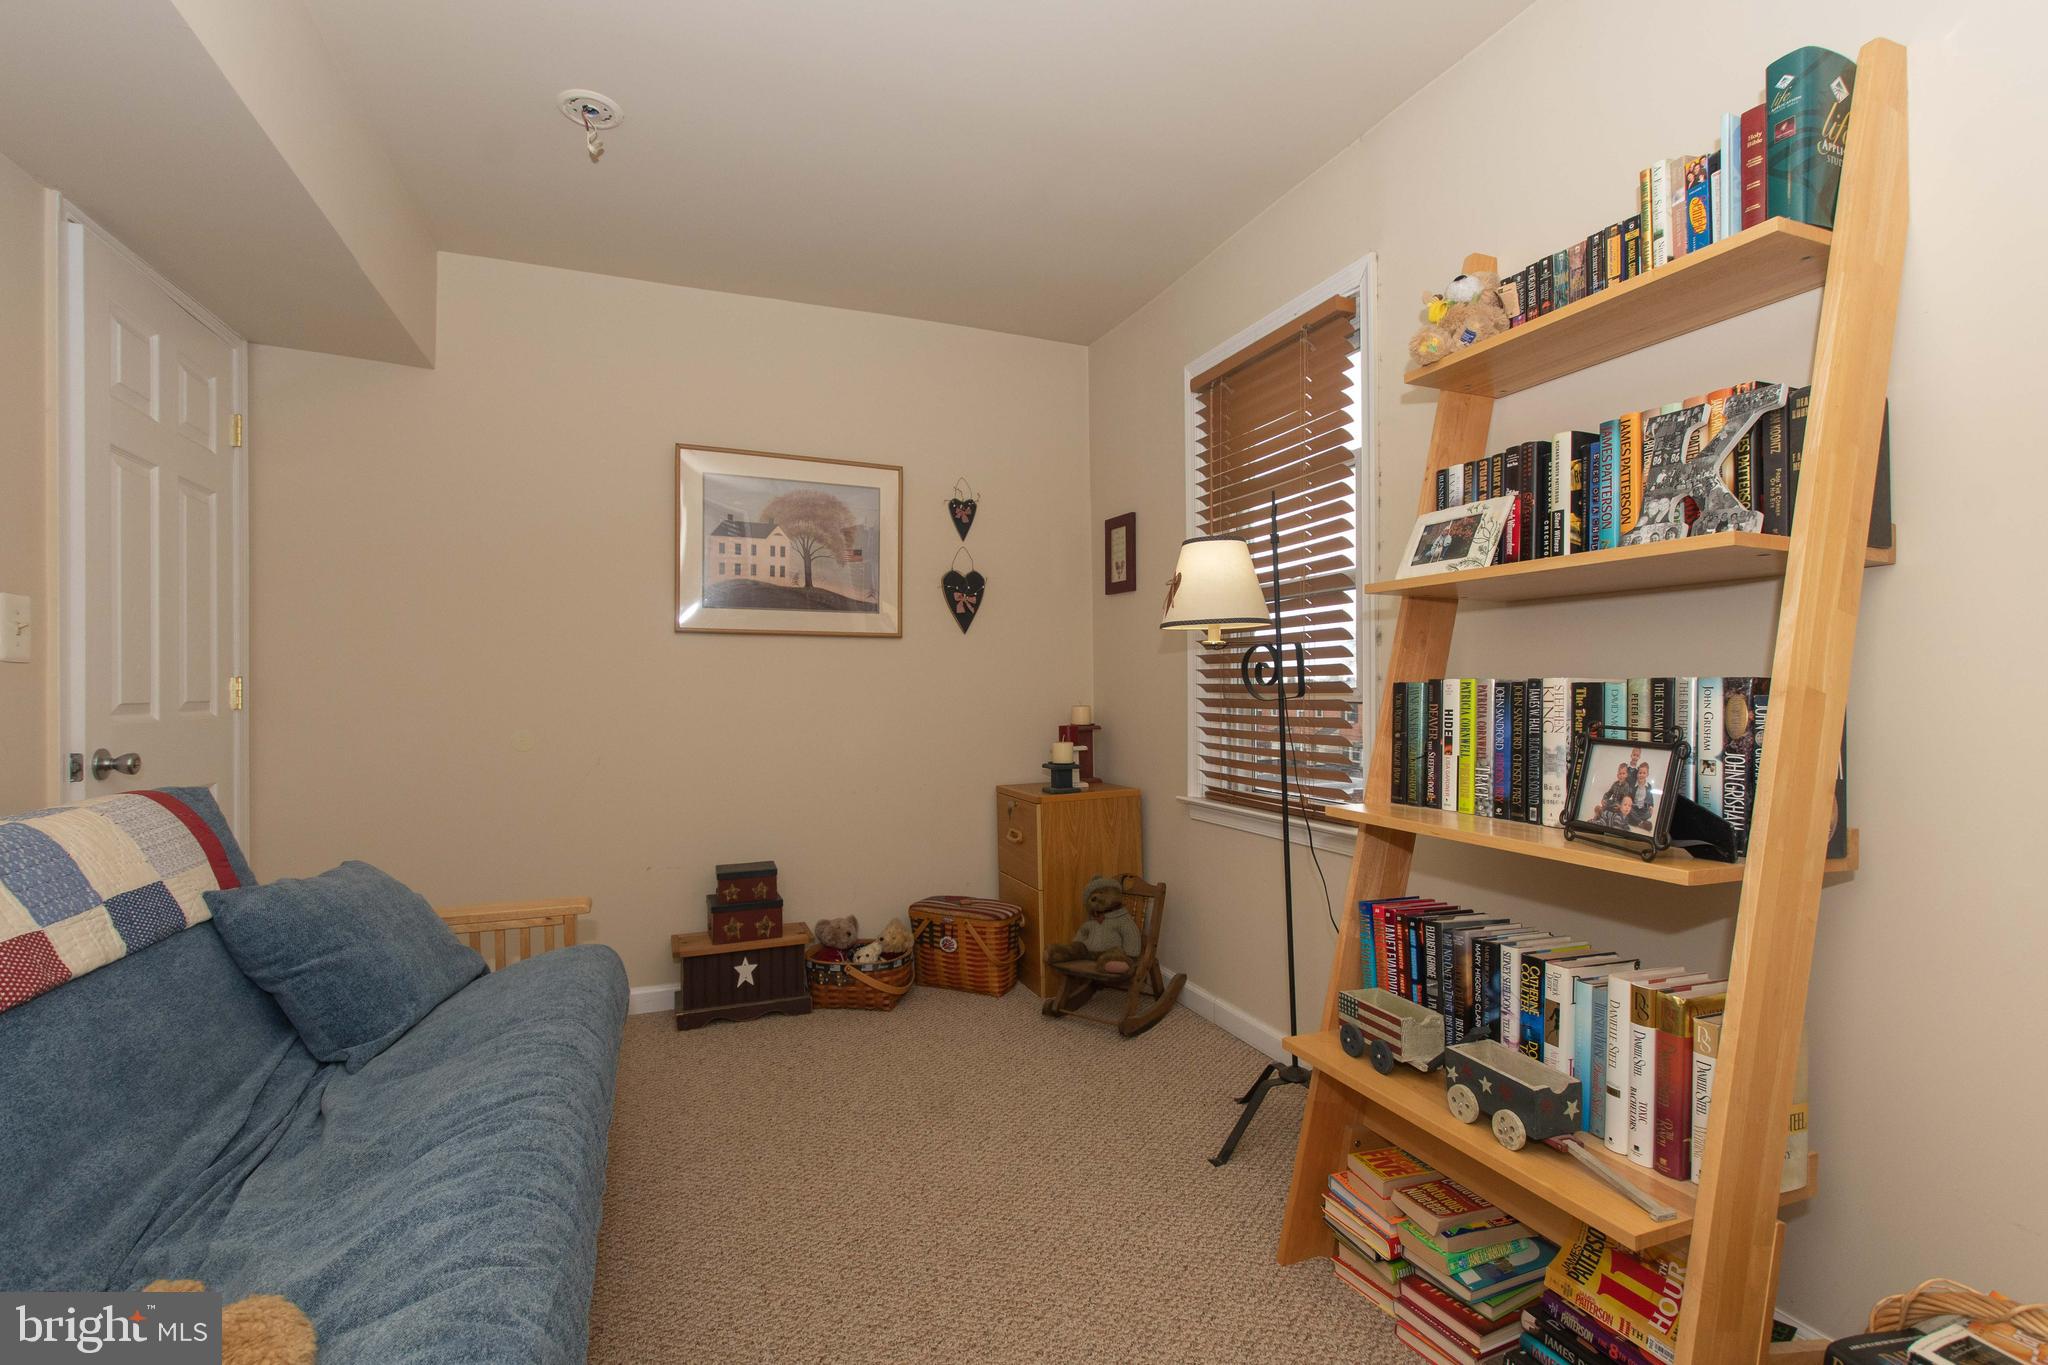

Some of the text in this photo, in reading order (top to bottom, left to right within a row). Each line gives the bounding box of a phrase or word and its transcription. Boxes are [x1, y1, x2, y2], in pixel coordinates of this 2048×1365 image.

[1747, 132, 1762, 141] Holy
[1747, 138, 1763, 148] Bible
[1528, 272, 1536, 290] DEAD
[1770, 424, 1781, 454] KOONTZ
[1464, 465, 1472, 494] STUART
[1479, 460, 1487, 491] STUART
[1493, 456, 1501, 486] STUART
[1592, 453, 1600, 482] EYES
[1601, 426, 1612, 529] JAMES PATTERSON
[1620, 419, 1631, 525] JAMES PATTERSON
[1738, 453, 1749, 511] PATTERSO
[1592, 488, 1600, 501] OF
[1592, 519, 1600, 550] CHIL
[1495, 686, 1504, 709] JOHN
[1528, 688, 1540, 708] JAMES
[1611, 688, 1619, 714] DAVID
[1630, 693, 1638, 716] PETER
[1654, 682, 1664, 697] THE
[1679, 681, 1688, 698] THE
[1428, 703, 1438, 740] DEAVER
[1444, 709, 1454, 737] HIDE
[1459, 681, 1471, 758] PATRICIA CORNWELL
[1476, 684, 1488, 761] PATRICIA CORNWELL
[1543, 685, 1554, 734] KING
[1554, 685, 1565, 734] STEPHEN
[1575, 687, 1587, 734] The Bear
[1703, 686, 1714, 751] JOHN GRISHAM
[1754, 704, 1768, 730] JOHN
[1495, 709, 1504, 751] SANDFORD
[1528, 718, 1540, 735] HALL
[1512, 685, 1523, 807] JOHN SANDFORD CHOSEN PREY
[1528, 737, 1540, 780] BLACKWATER
[1427, 751, 1436, 779] SLEEPING
[1475, 765, 1491, 800] TRACE
[1528, 780, 1540, 805] SOUND
[1724, 751, 1745, 831] JOHN GRISHAM
[1385, 924, 1397, 951] JANET
[1426, 925, 1436, 979] ELIZABETH GEORGE
[1443, 948, 1454, 960] NO
[1502, 951, 1512, 977] SIDNEY
[1443, 962, 1454, 977] ONE
[1443, 991, 1454, 1012] TRUST
[1502, 977, 1512, 1012] SHELDON
[1520, 963, 1530, 1012] COULTER
[1530, 966, 1540, 1017] CATHERINE
[1443, 1026, 1454, 1045] JOHAN
[1502, 1018, 1512, 1035] TELL
[1608, 1000, 1620, 1069] DANIELLE STEEL
[1632, 1030, 1646, 1077] DANIELLE STEEL
[1696, 1060, 1712, 1116] DANIELLE STEEL
[1630, 1086, 1638, 1132] BACHELORS
[1639, 1101, 1648, 1125] TOXIC
[1403, 1188, 1452, 1215] Nineteen
[1419, 1182, 1468, 1213] Notorious
[1562, 1243, 1582, 1272] JAMES
[1567, 1226, 1606, 1285] PATTERSO
[1575, 1293, 1614, 1326] PATTERSON
[1648, 1261, 1687, 1334] HOUR
[1560, 1312, 1594, 1344] PATTERSON
[1544, 1334, 1576, 1364] JAMES
